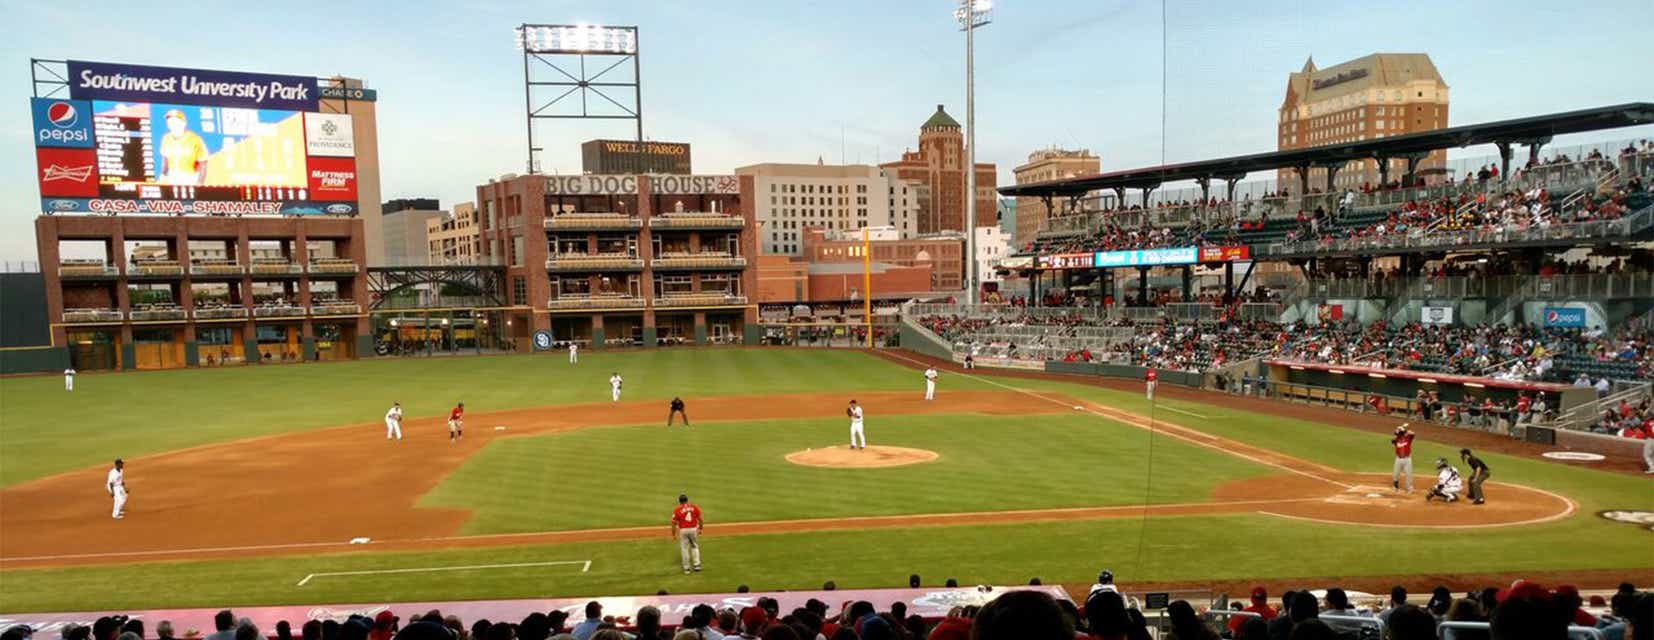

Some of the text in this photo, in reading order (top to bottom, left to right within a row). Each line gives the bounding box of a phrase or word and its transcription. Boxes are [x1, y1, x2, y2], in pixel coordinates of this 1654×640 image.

[80, 69, 309, 102] Southwest University Park
[39, 128, 88, 143] pepsi
[647, 144, 685, 155] FARGO
[545, 175, 716, 194] BIG DOG HOUSE
[192, 200, 283, 214] SHAMALEY
